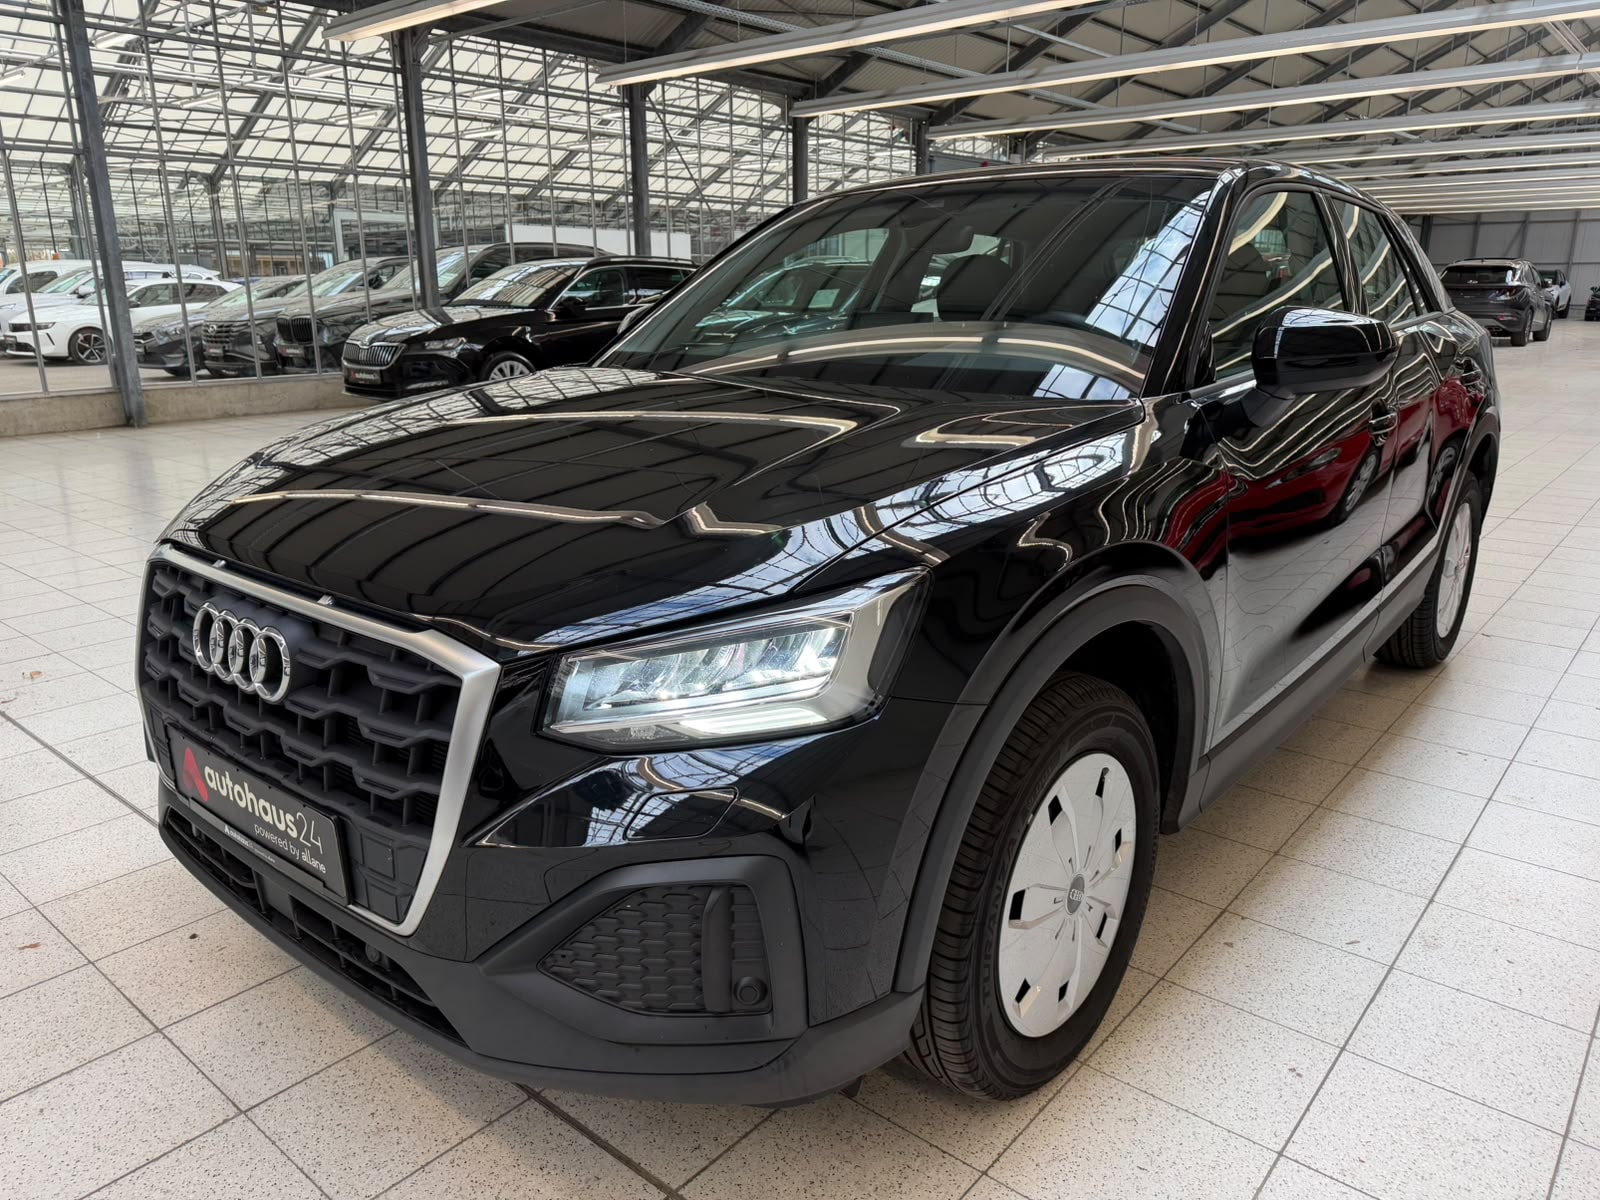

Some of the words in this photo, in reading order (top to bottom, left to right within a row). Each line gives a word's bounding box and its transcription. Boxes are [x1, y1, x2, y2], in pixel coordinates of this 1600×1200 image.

[254, 824, 289, 850] powered
[289, 841, 300, 860] by
[301, 848, 326, 873] allane
